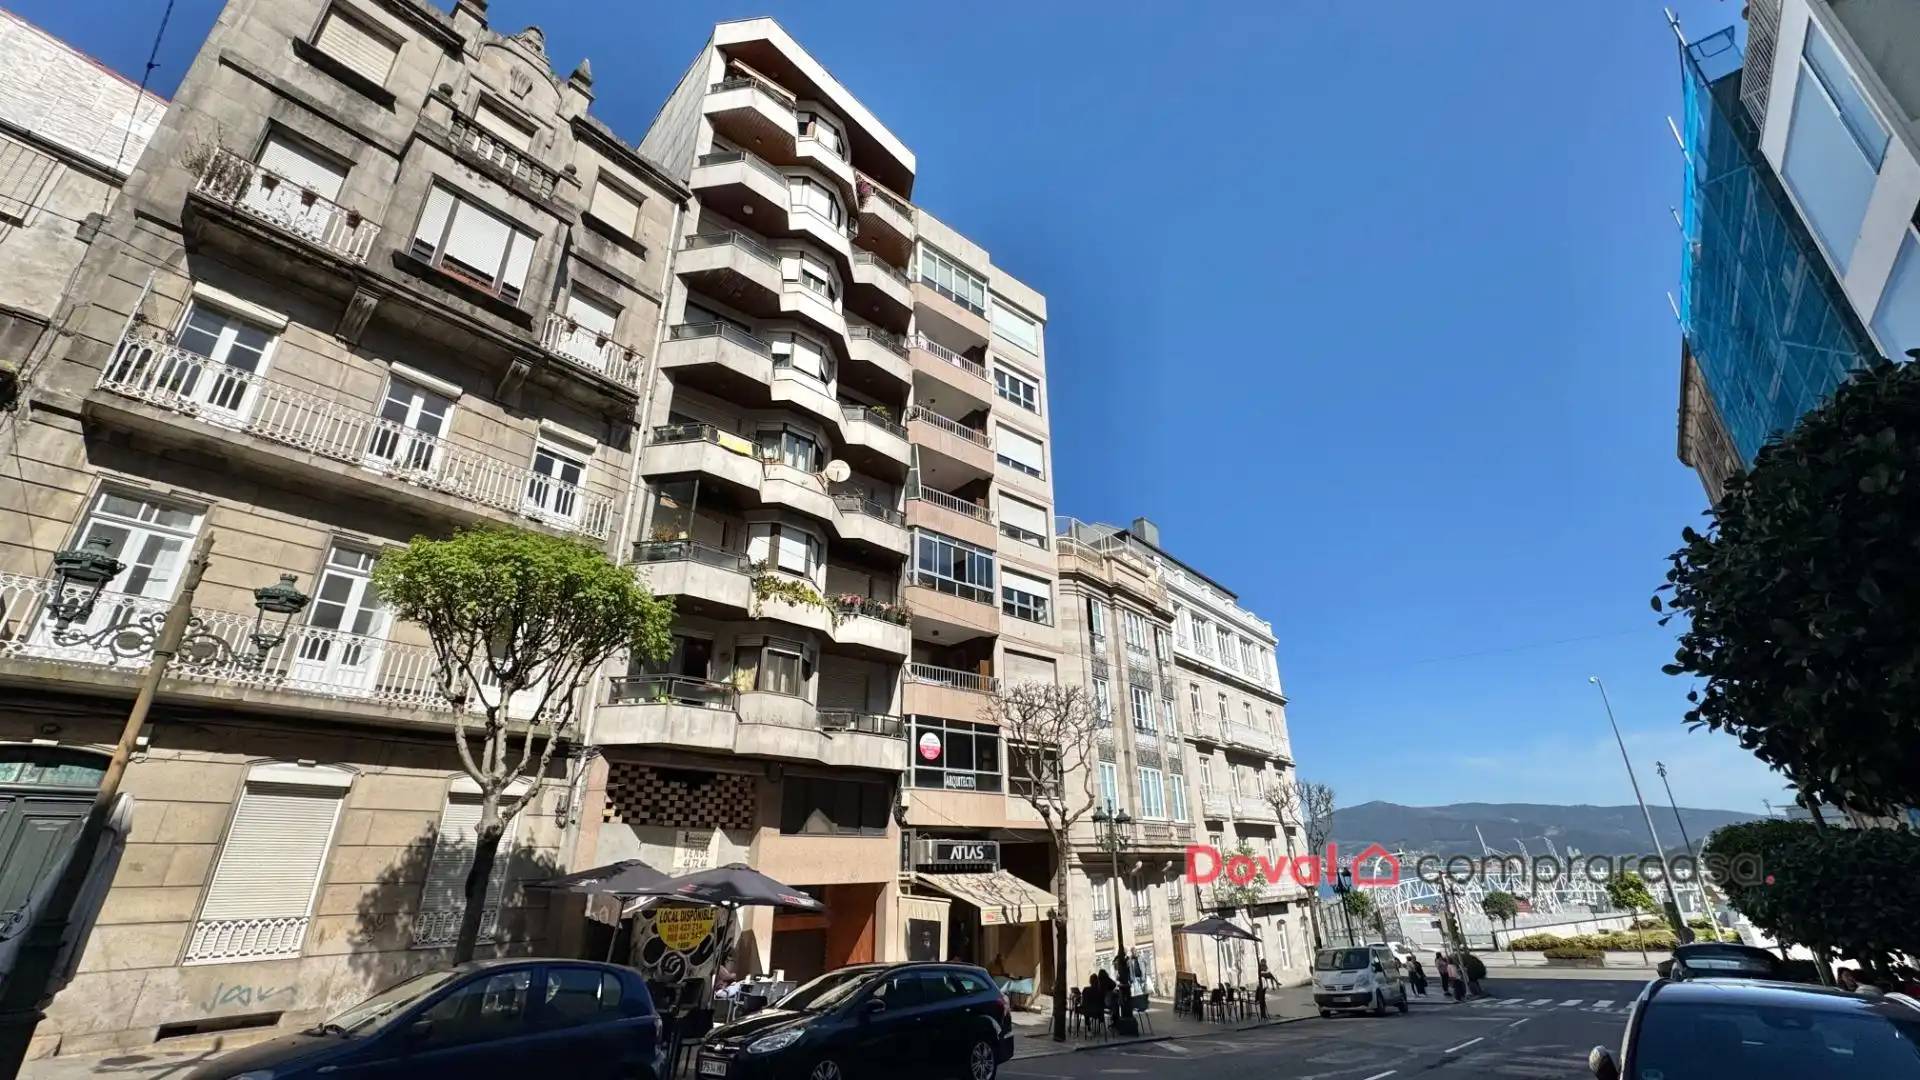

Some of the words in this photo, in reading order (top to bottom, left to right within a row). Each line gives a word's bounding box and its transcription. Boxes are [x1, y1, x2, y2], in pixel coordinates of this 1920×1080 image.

[683, 849, 709, 858] VENDE
[950, 845, 984, 860] ATLAS
[659, 910, 680, 924] LOCAL
[680, 908, 714, 921] DISPONIBLE
